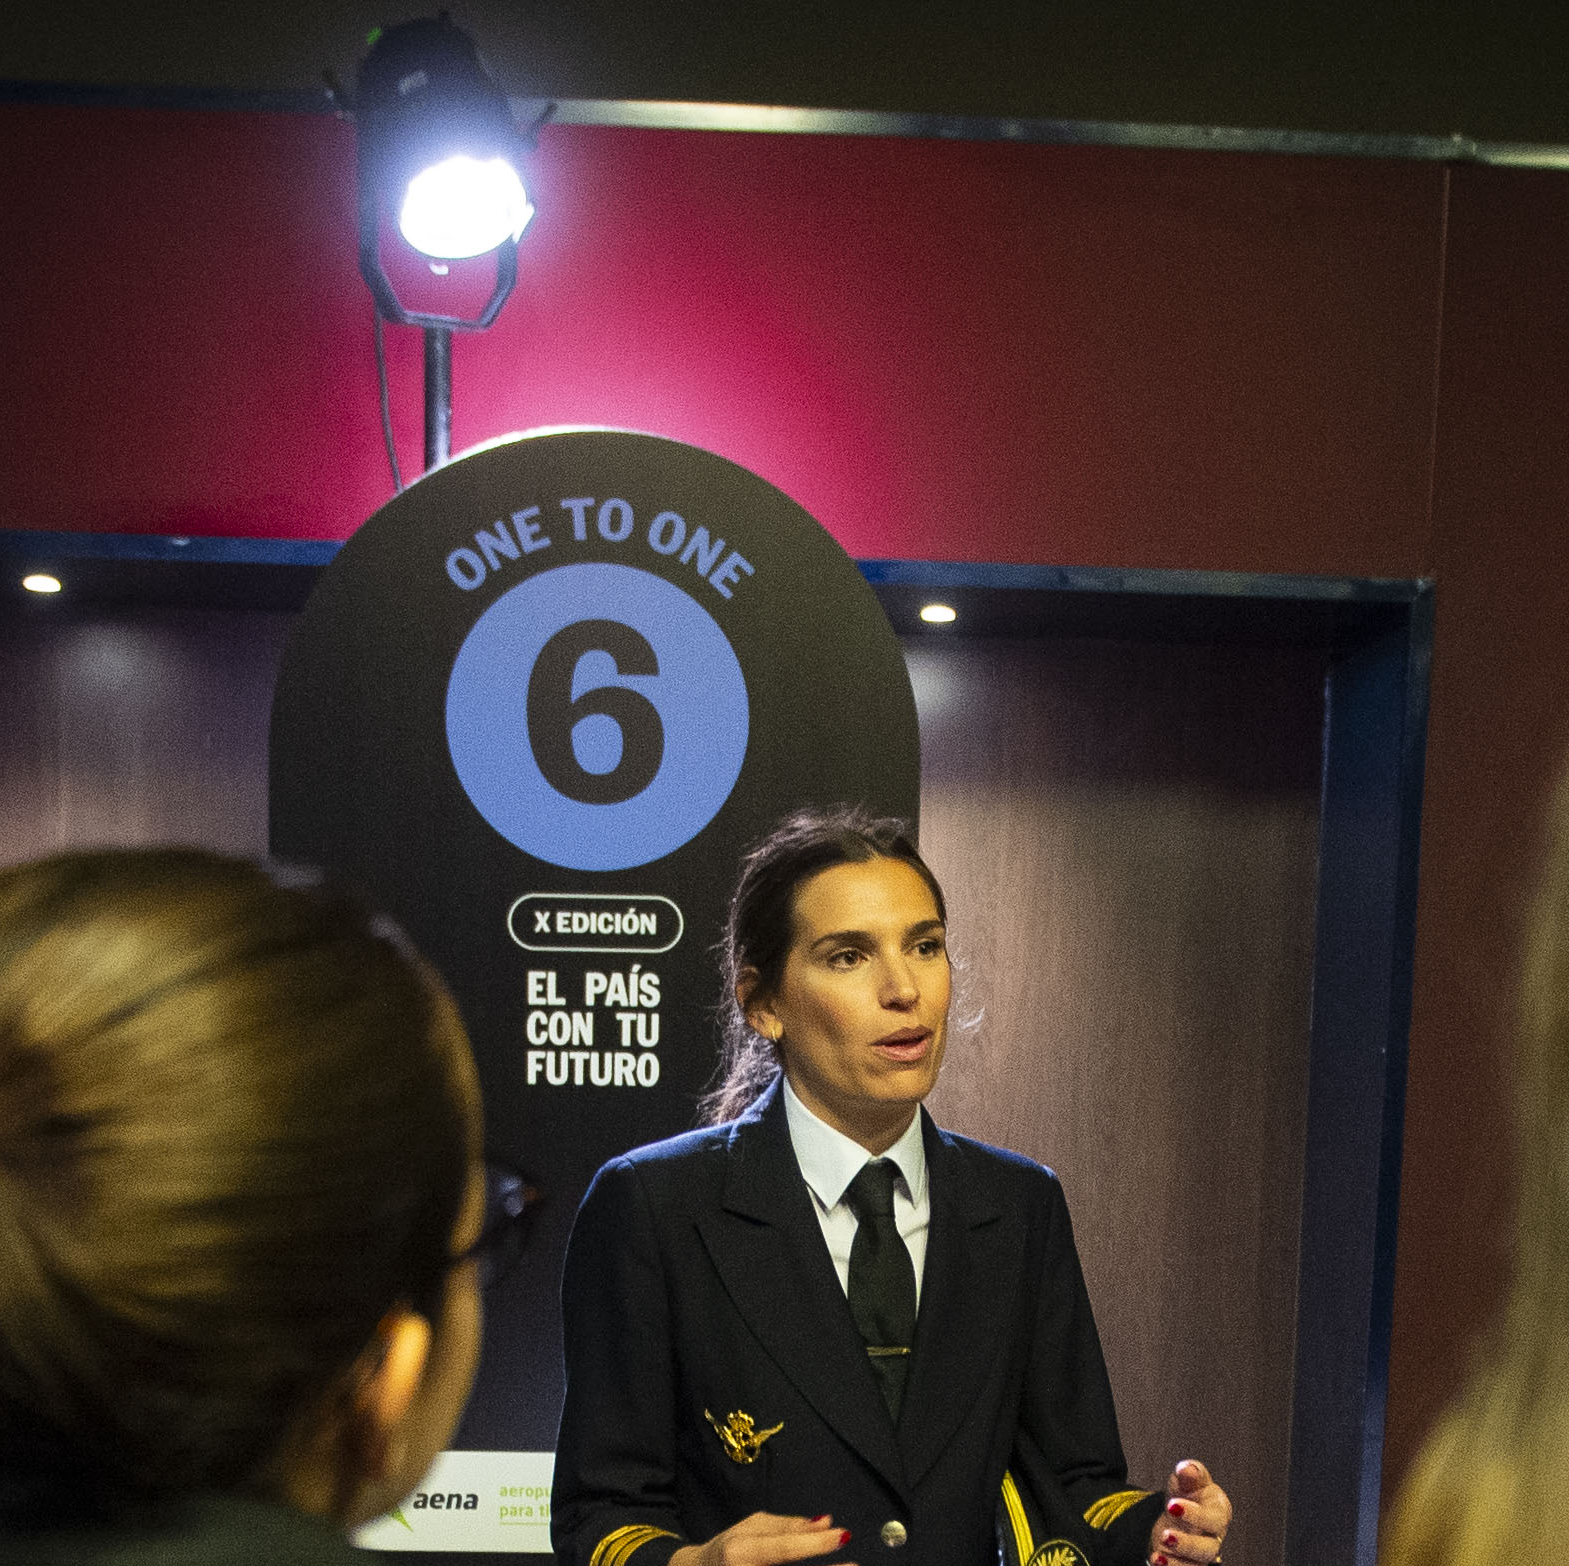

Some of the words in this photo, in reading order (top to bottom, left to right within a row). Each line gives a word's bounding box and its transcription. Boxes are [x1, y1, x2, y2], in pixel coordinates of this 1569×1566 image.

[445, 505, 552, 591] ONE
[560, 497, 634, 543] TO
[647, 511, 756, 600] ONE
[525, 618, 665, 806] 6
[534, 911, 550, 934] X
[556, 907, 657, 935] EDICIÓN
[527, 971, 566, 1006] EL
[585, 963, 661, 1008] PAÍS
[526, 1010, 593, 1046] CON
[615, 1012, 659, 1048] TU
[527, 1051, 660, 1087] FUTURO
[413, 1492, 479, 1511] aena
[499, 1504, 534, 1520] para
